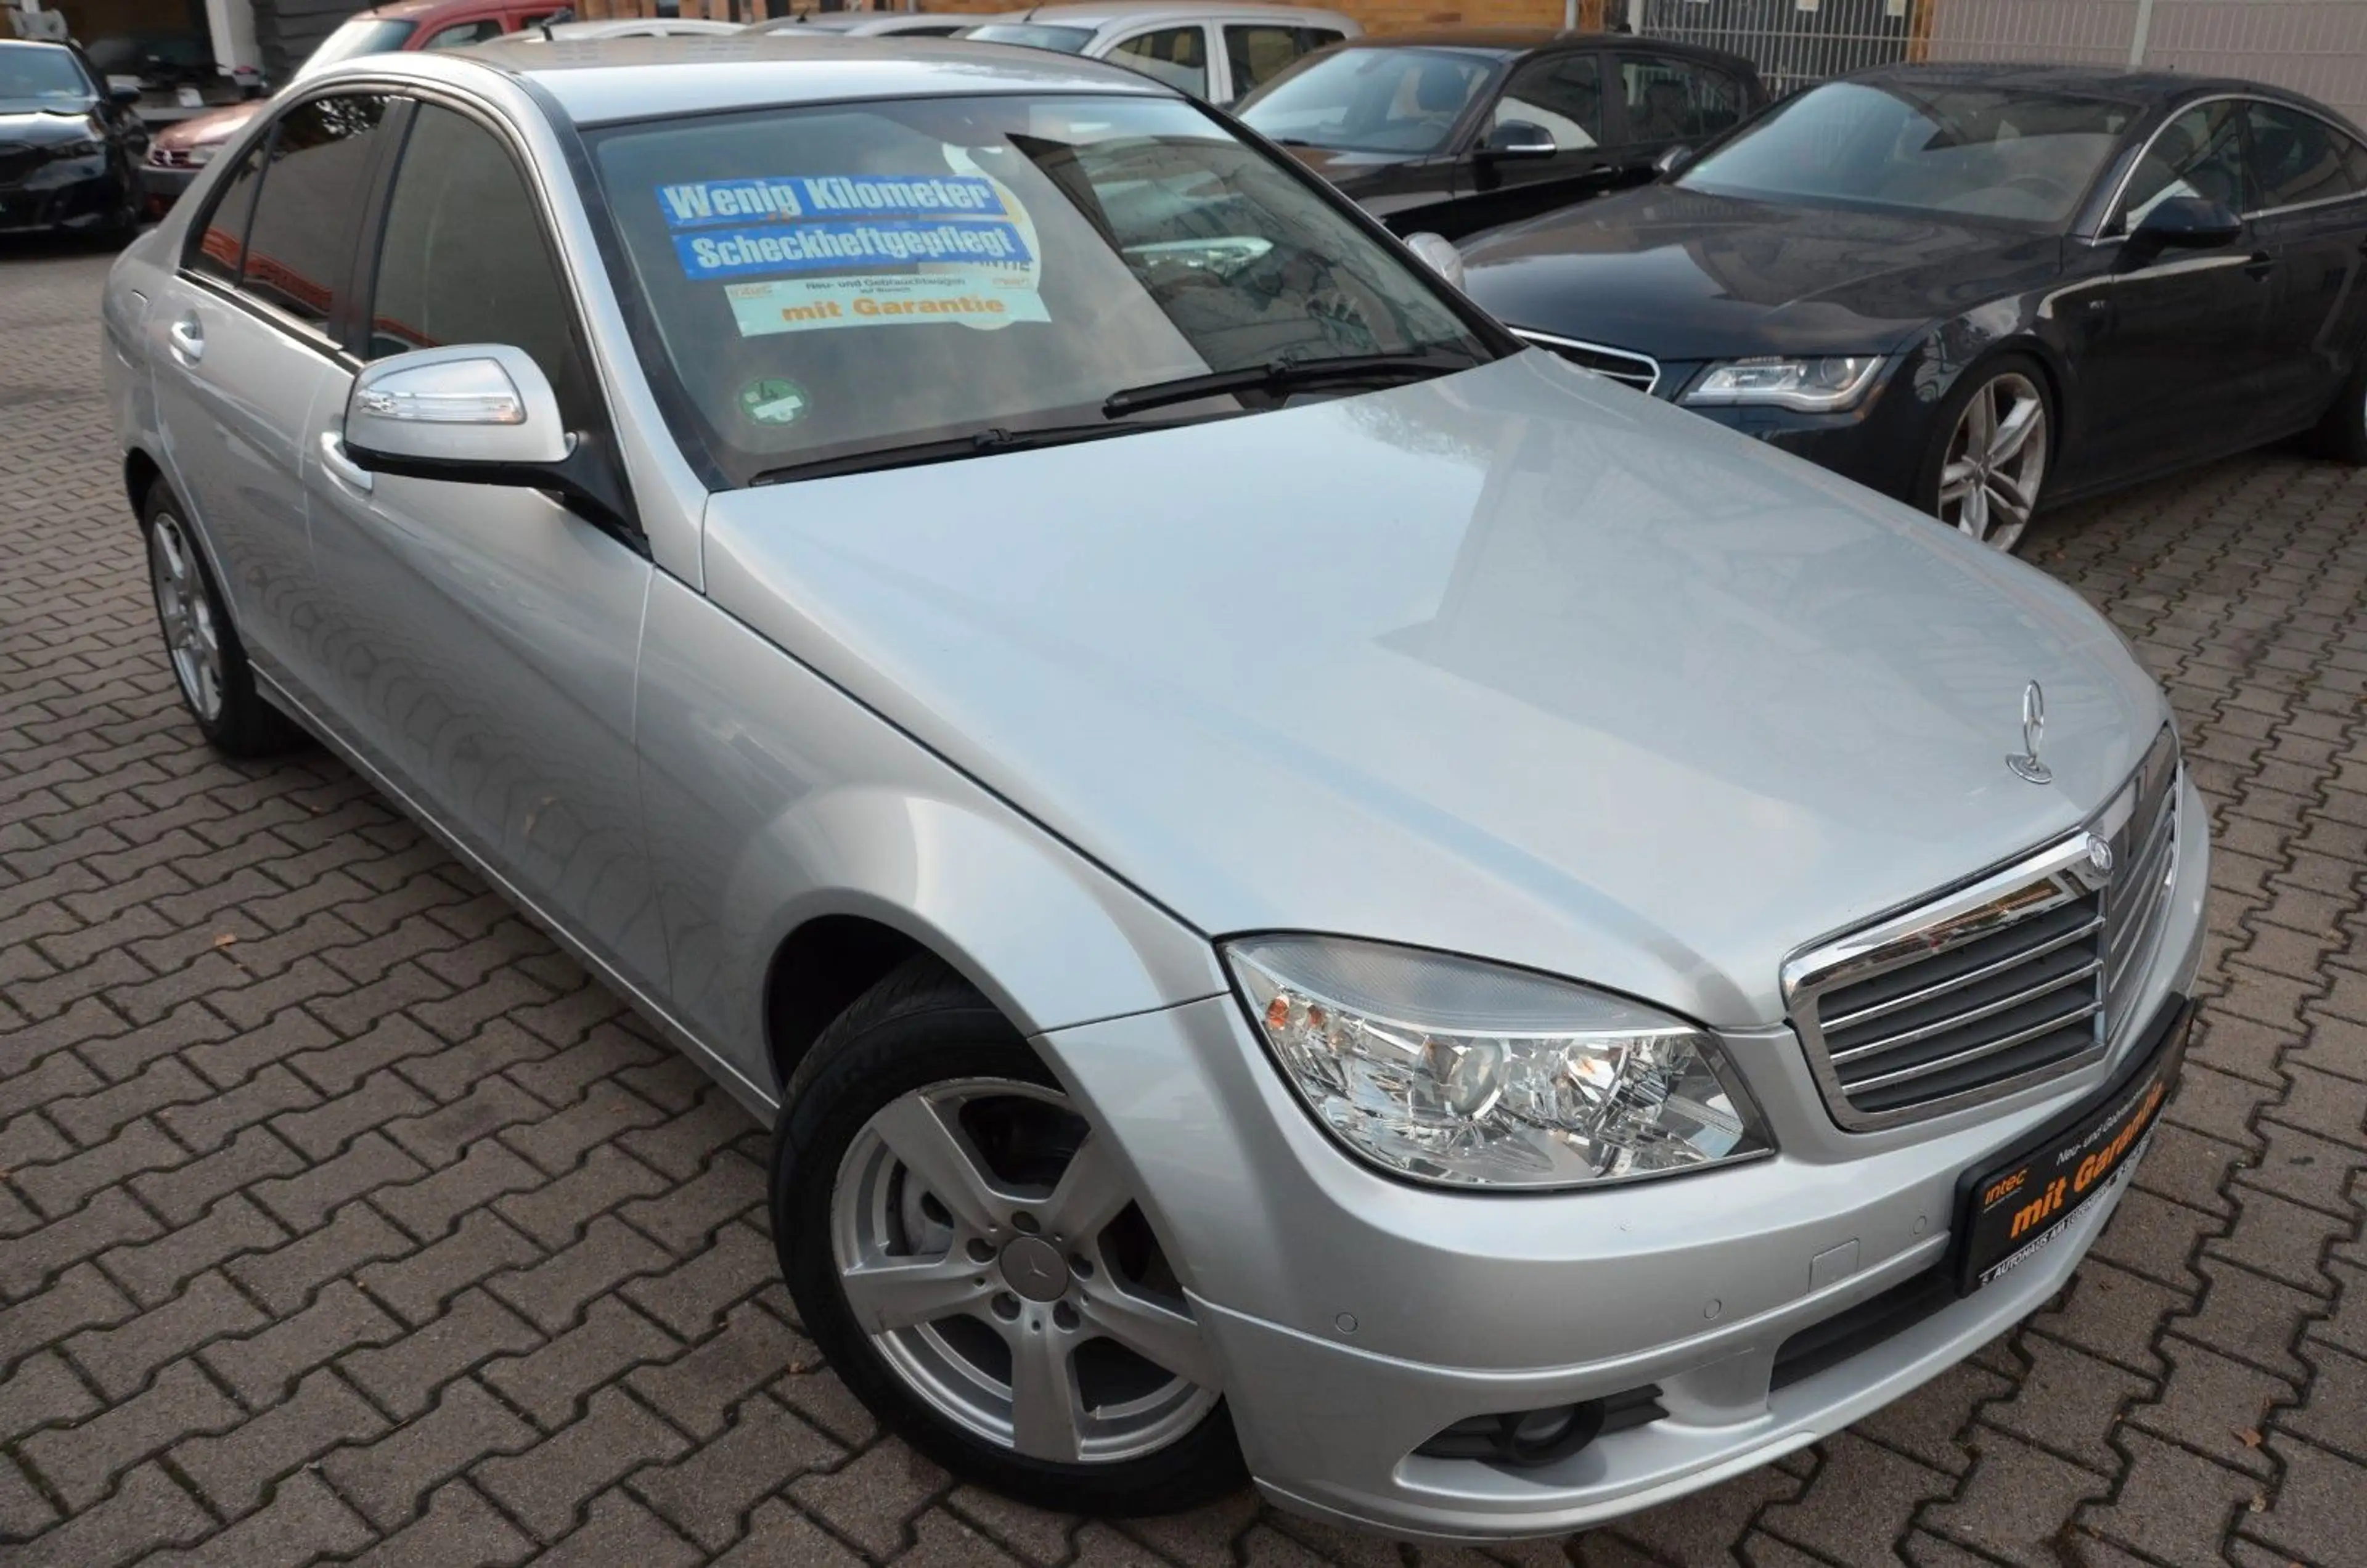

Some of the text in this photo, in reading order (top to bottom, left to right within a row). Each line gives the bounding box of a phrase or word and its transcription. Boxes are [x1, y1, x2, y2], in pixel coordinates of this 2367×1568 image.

[663, 176, 991, 219] Wenig Kilometer
[691, 226, 1016, 269] Scheckheftgepflegt
[782, 295, 1007, 322] mit Garantie
[1985, 1168, 2029, 1206] intec
[2010, 1175, 2067, 1239] mit
